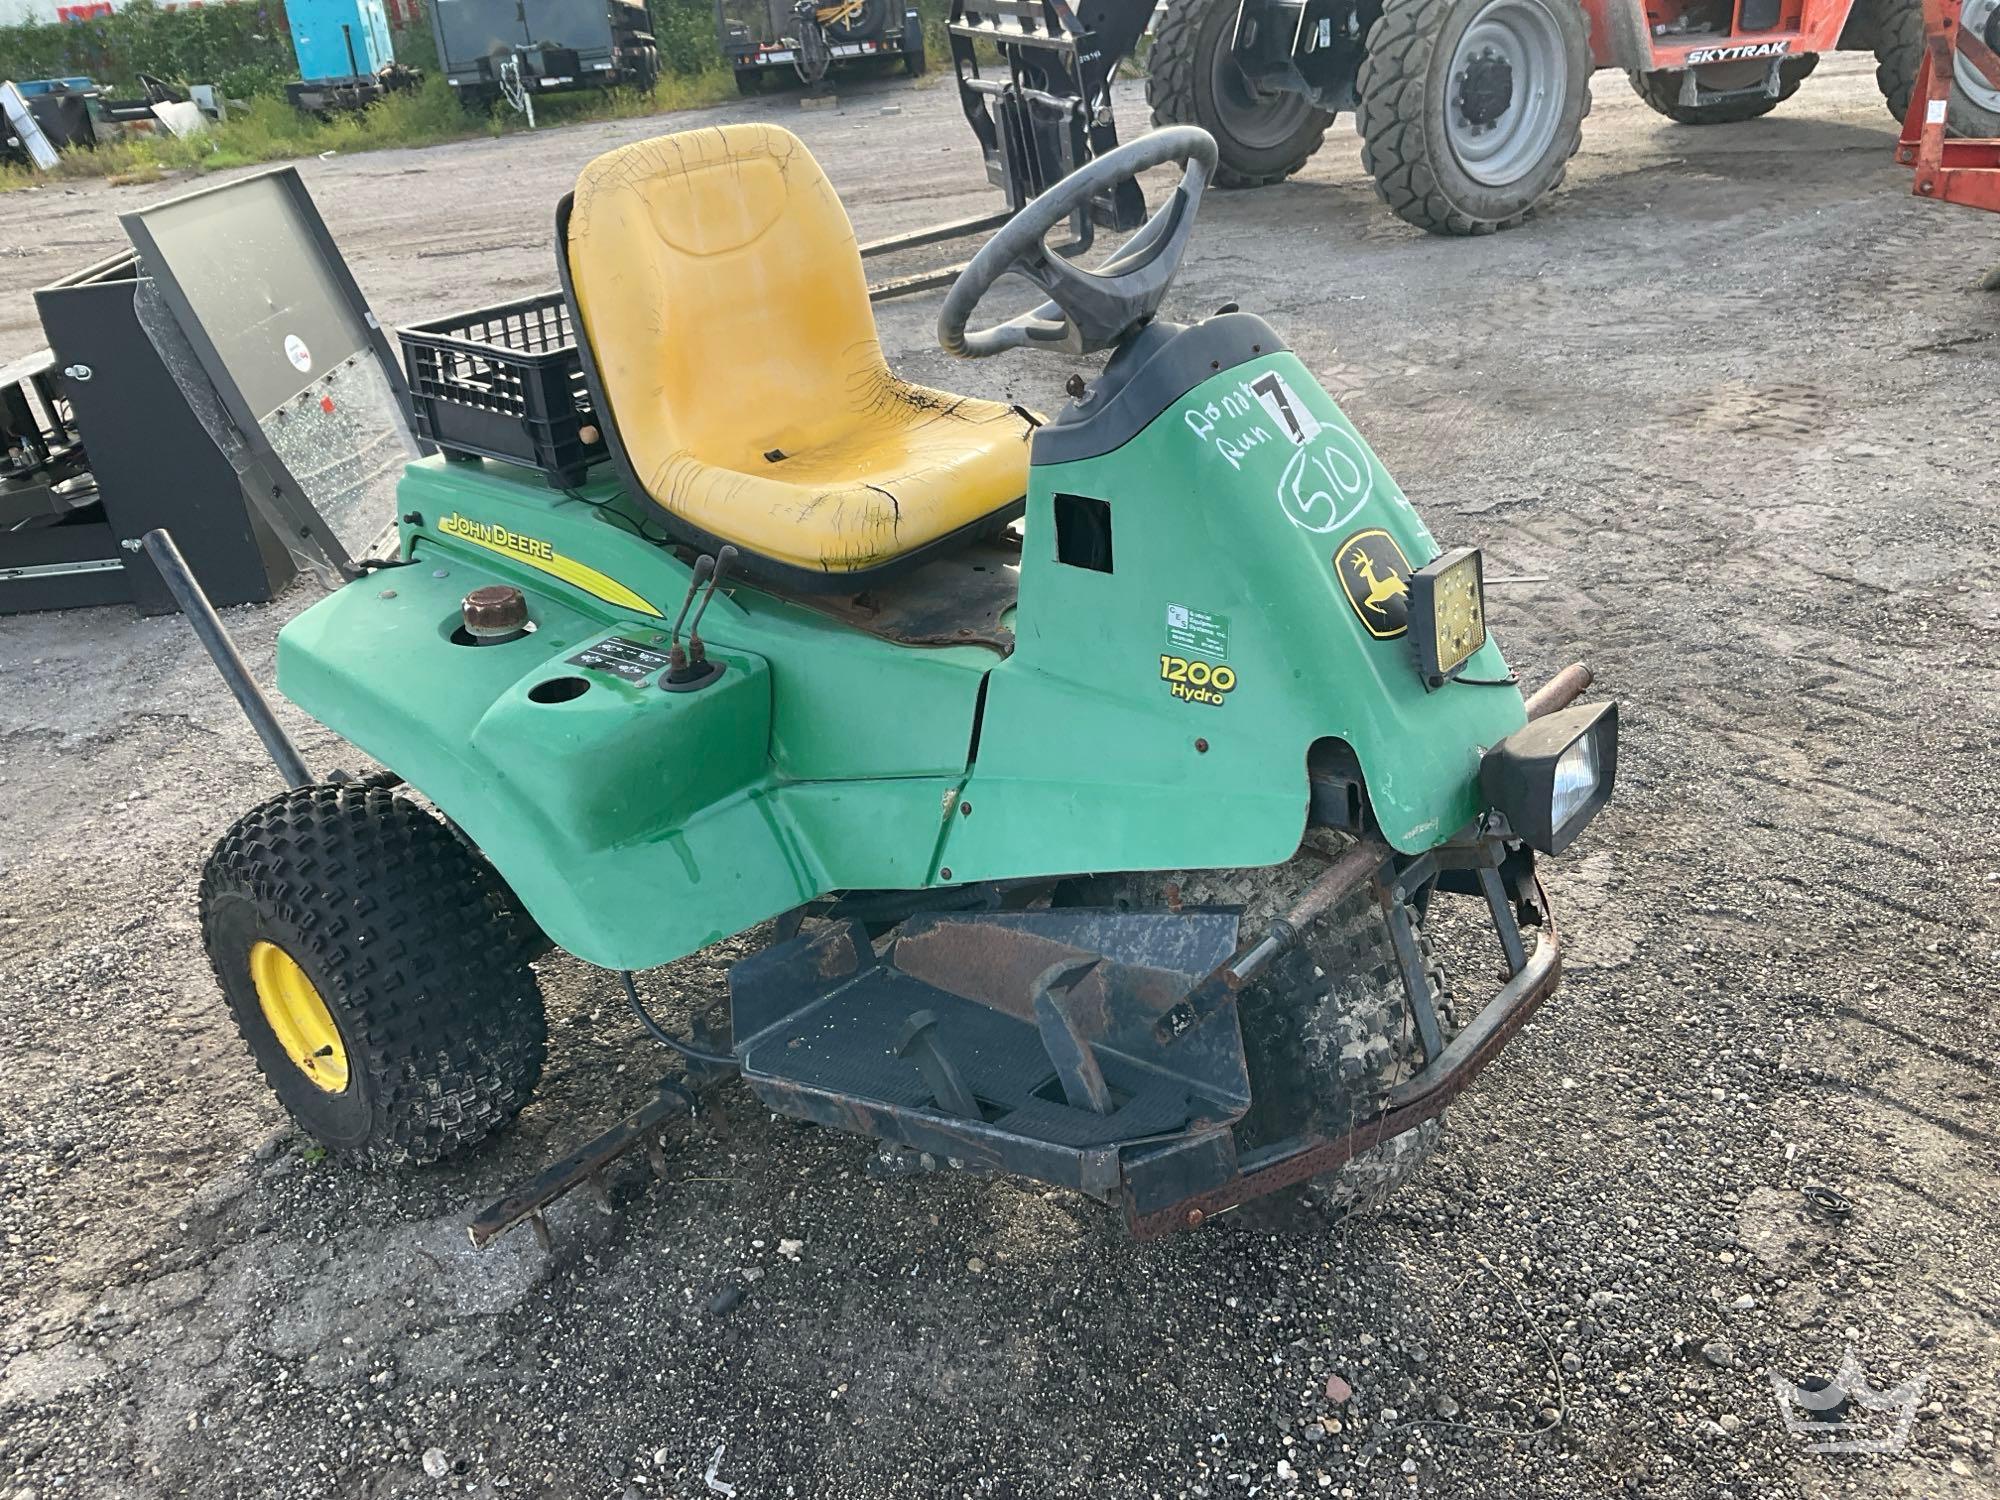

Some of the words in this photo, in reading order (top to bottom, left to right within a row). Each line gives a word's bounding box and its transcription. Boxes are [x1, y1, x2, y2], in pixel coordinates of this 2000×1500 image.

[1687, 41, 1788, 64] SKYTRAK
[1216, 426, 1272, 470] Run
[1292, 447, 1360, 528] 510
[447, 512, 492, 543] JOHN
[492, 524, 553, 560] DEERE
[1160, 655, 1236, 692] 1200
[1172, 682, 1224, 705] Hydro
